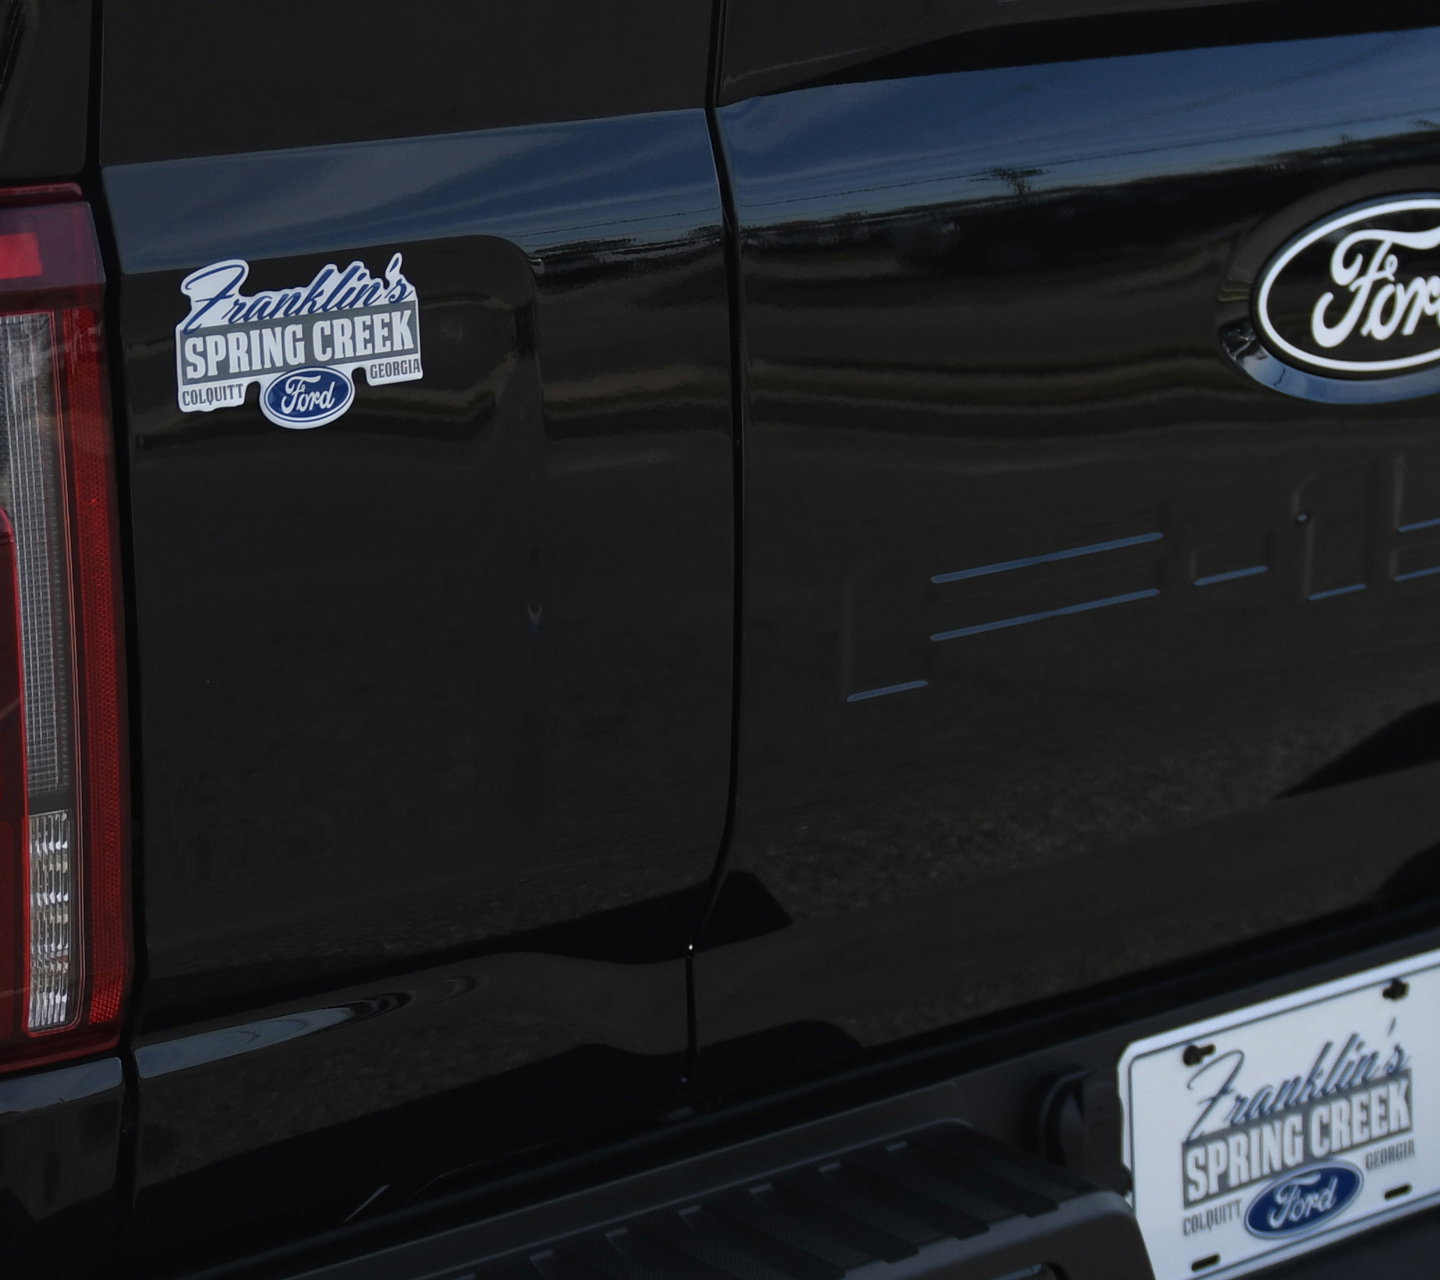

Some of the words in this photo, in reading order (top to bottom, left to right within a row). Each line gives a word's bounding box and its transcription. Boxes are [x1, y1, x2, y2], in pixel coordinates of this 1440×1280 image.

[184, 257, 412, 335] Franklin's
[185, 322, 305, 379] SPRING
[313, 310, 414, 362] CREEK
[370, 358, 420, 379] GEORGIA
[182, 384, 243, 407] COLQUITT
[281, 375, 336, 414] Ford
[1186, 1017, 1410, 1142] Franklin's
[1186, 1126, 1304, 1202] SPRING
[1310, 1079, 1411, 1158] CREEK
[1365, 1140, 1415, 1170] GEORGIA
[1183, 1199, 1242, 1236] COLQUITT
[1269, 1173, 1338, 1228] Ford
